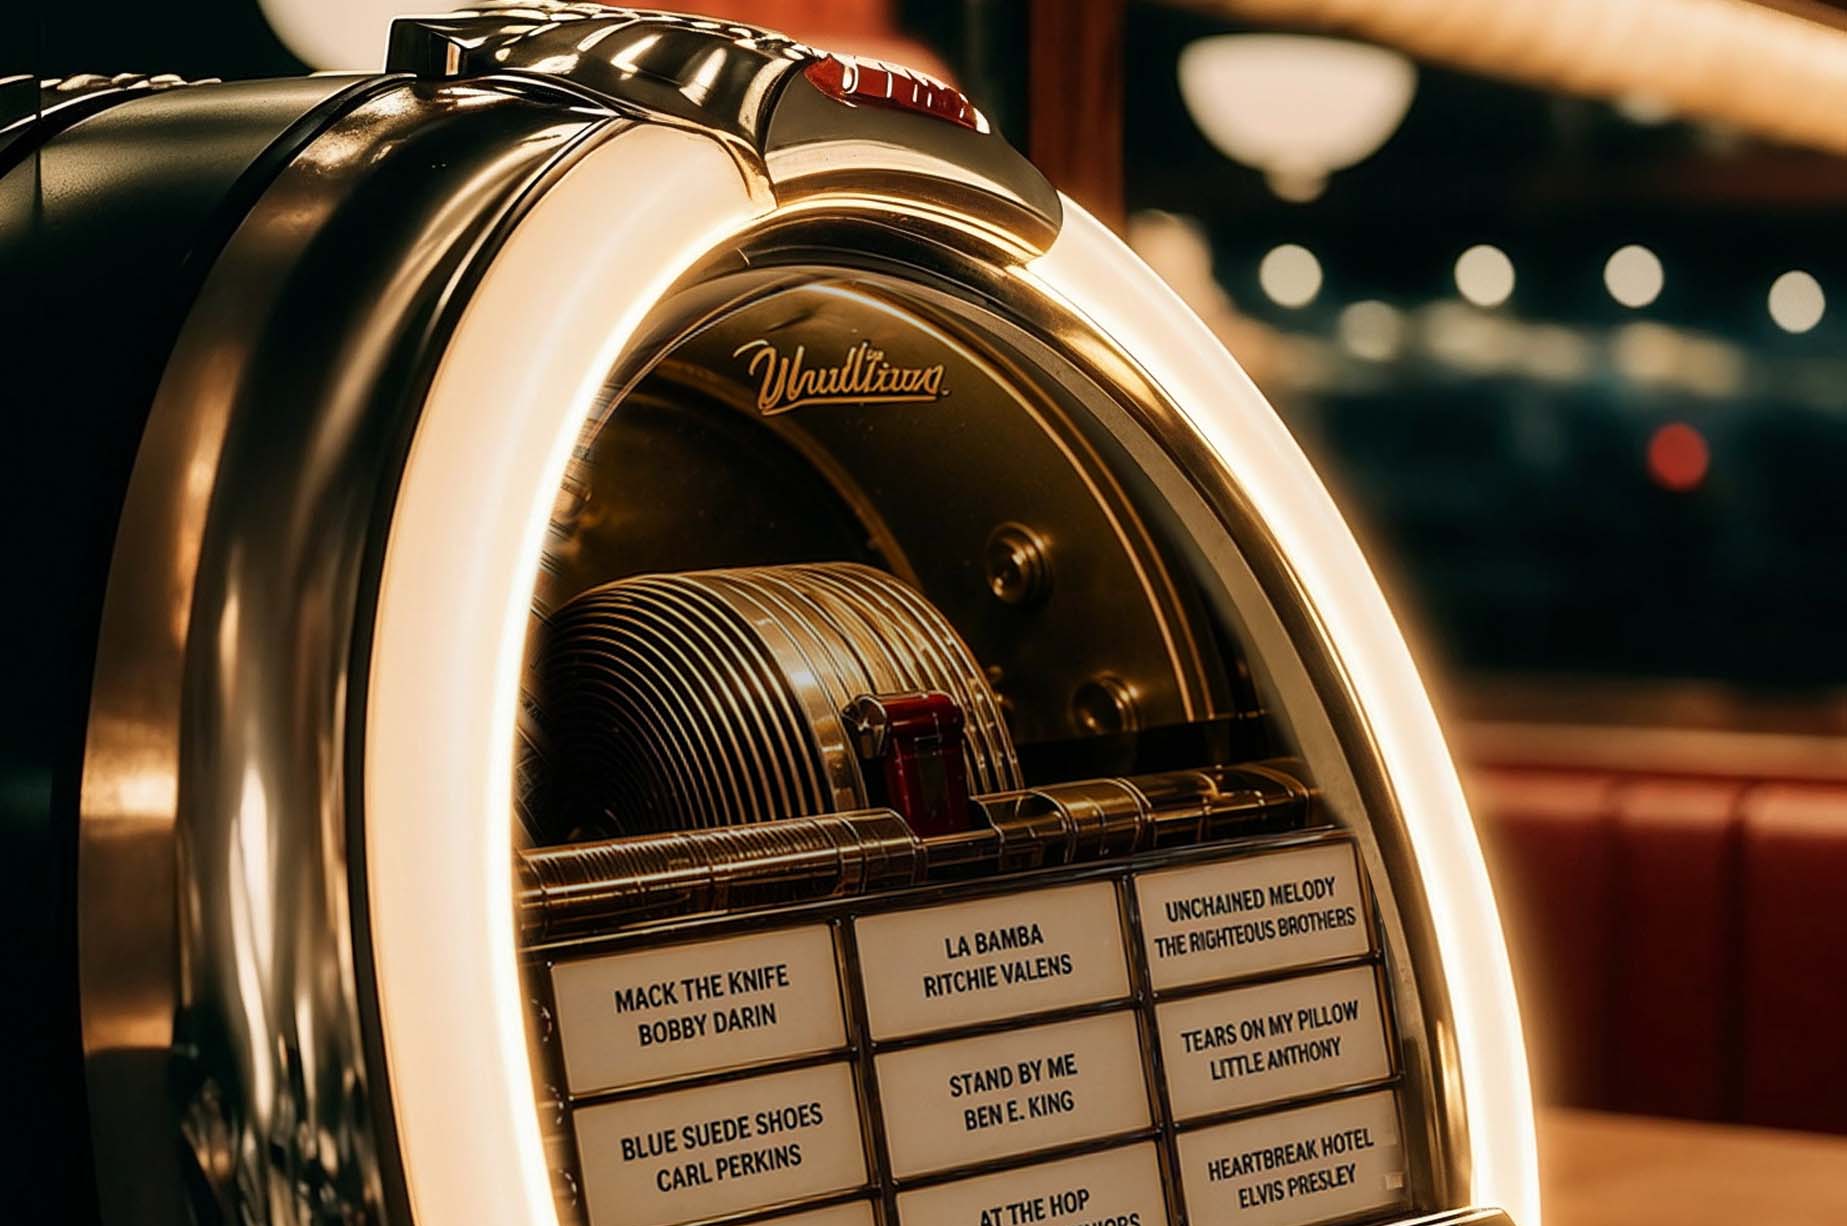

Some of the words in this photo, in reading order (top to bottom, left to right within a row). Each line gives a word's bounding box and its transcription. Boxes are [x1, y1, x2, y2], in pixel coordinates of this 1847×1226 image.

[1165, 888, 1265, 923] UNCHAINED
[1268, 876, 1335, 907] MELODY
[944, 935, 972, 960] LA
[974, 923, 1044, 955] BAMBA
[1153, 934, 1188, 959] THE
[1188, 919, 1277, 953] RIGHTEOUS
[1277, 906, 1357, 937] BROTHERS
[614, 981, 679, 1014] MACK
[680, 974, 725, 1002] THE
[727, 963, 790, 995] KNIFE
[923, 962, 999, 998] RITCHIE
[999, 953, 1073, 985] VALENS
[637, 1013, 707, 1047] BOBBY
[712, 1002, 777, 1034] DARIN
[1180, 1023, 1238, 1053] TEARS
[1240, 1017, 1266, 1042] ON
[1268, 1012, 1294, 1037] MY
[1297, 999, 1359, 1031] PILLOW
[949, 1065, 1014, 1098] STAND
[1017, 1059, 1042, 1085] BY
[1046, 1053, 1078, 1079] ME
[1210, 1051, 1265, 1081] LITTLE
[1267, 1036, 1341, 1071] ANTHONY
[620, 1129, 678, 1162] BLUE
[681, 1115, 753, 1150] SUEDE
[755, 1102, 824, 1136] SHOES
[964, 1103, 1004, 1131] BEN
[1006, 1099, 1025, 1123] E.
[1027, 1089, 1075, 1119] KING
[656, 1161, 714, 1193] CARL
[715, 1143, 802, 1181] PERKINS
[1207, 1139, 1319, 1182] HEARTBREAK
[1320, 1128, 1375, 1157] HOTEL
[1005, 1197, 1046, 1226] THE
[1049, 1188, 1090, 1218] HOP
[1238, 1182, 1285, 1209] ELVIS
[1286, 1162, 1356, 1198] PRESLEY
